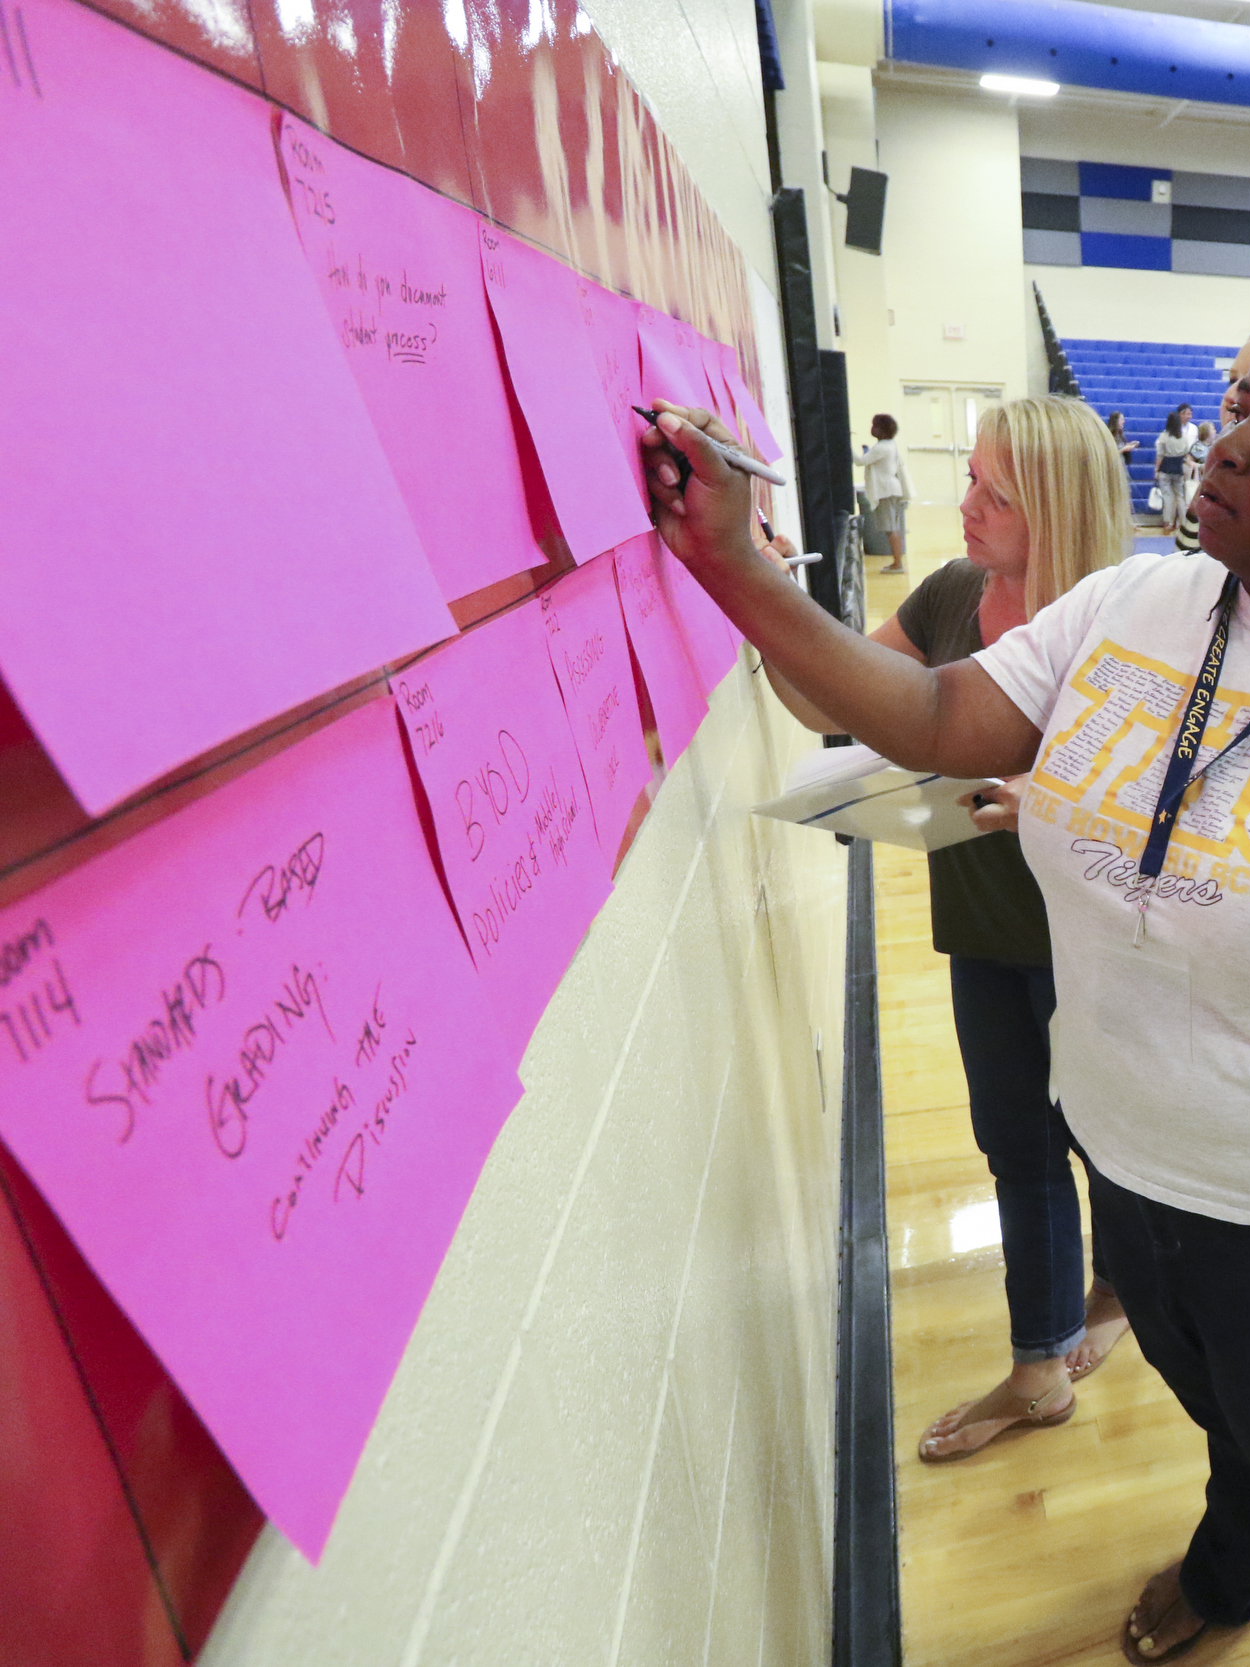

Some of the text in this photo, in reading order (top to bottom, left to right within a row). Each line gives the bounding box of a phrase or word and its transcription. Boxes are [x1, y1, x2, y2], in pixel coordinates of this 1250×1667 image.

[1202, 625, 1227, 686] CREATE
[1177, 688, 1210, 759] ENGAGE
[455, 729, 530, 862] BYOD
[1065, 806, 1201, 878] HOWRD
[1071, 838, 1223, 906] Tigers
[0, 917, 54, 986] oom
